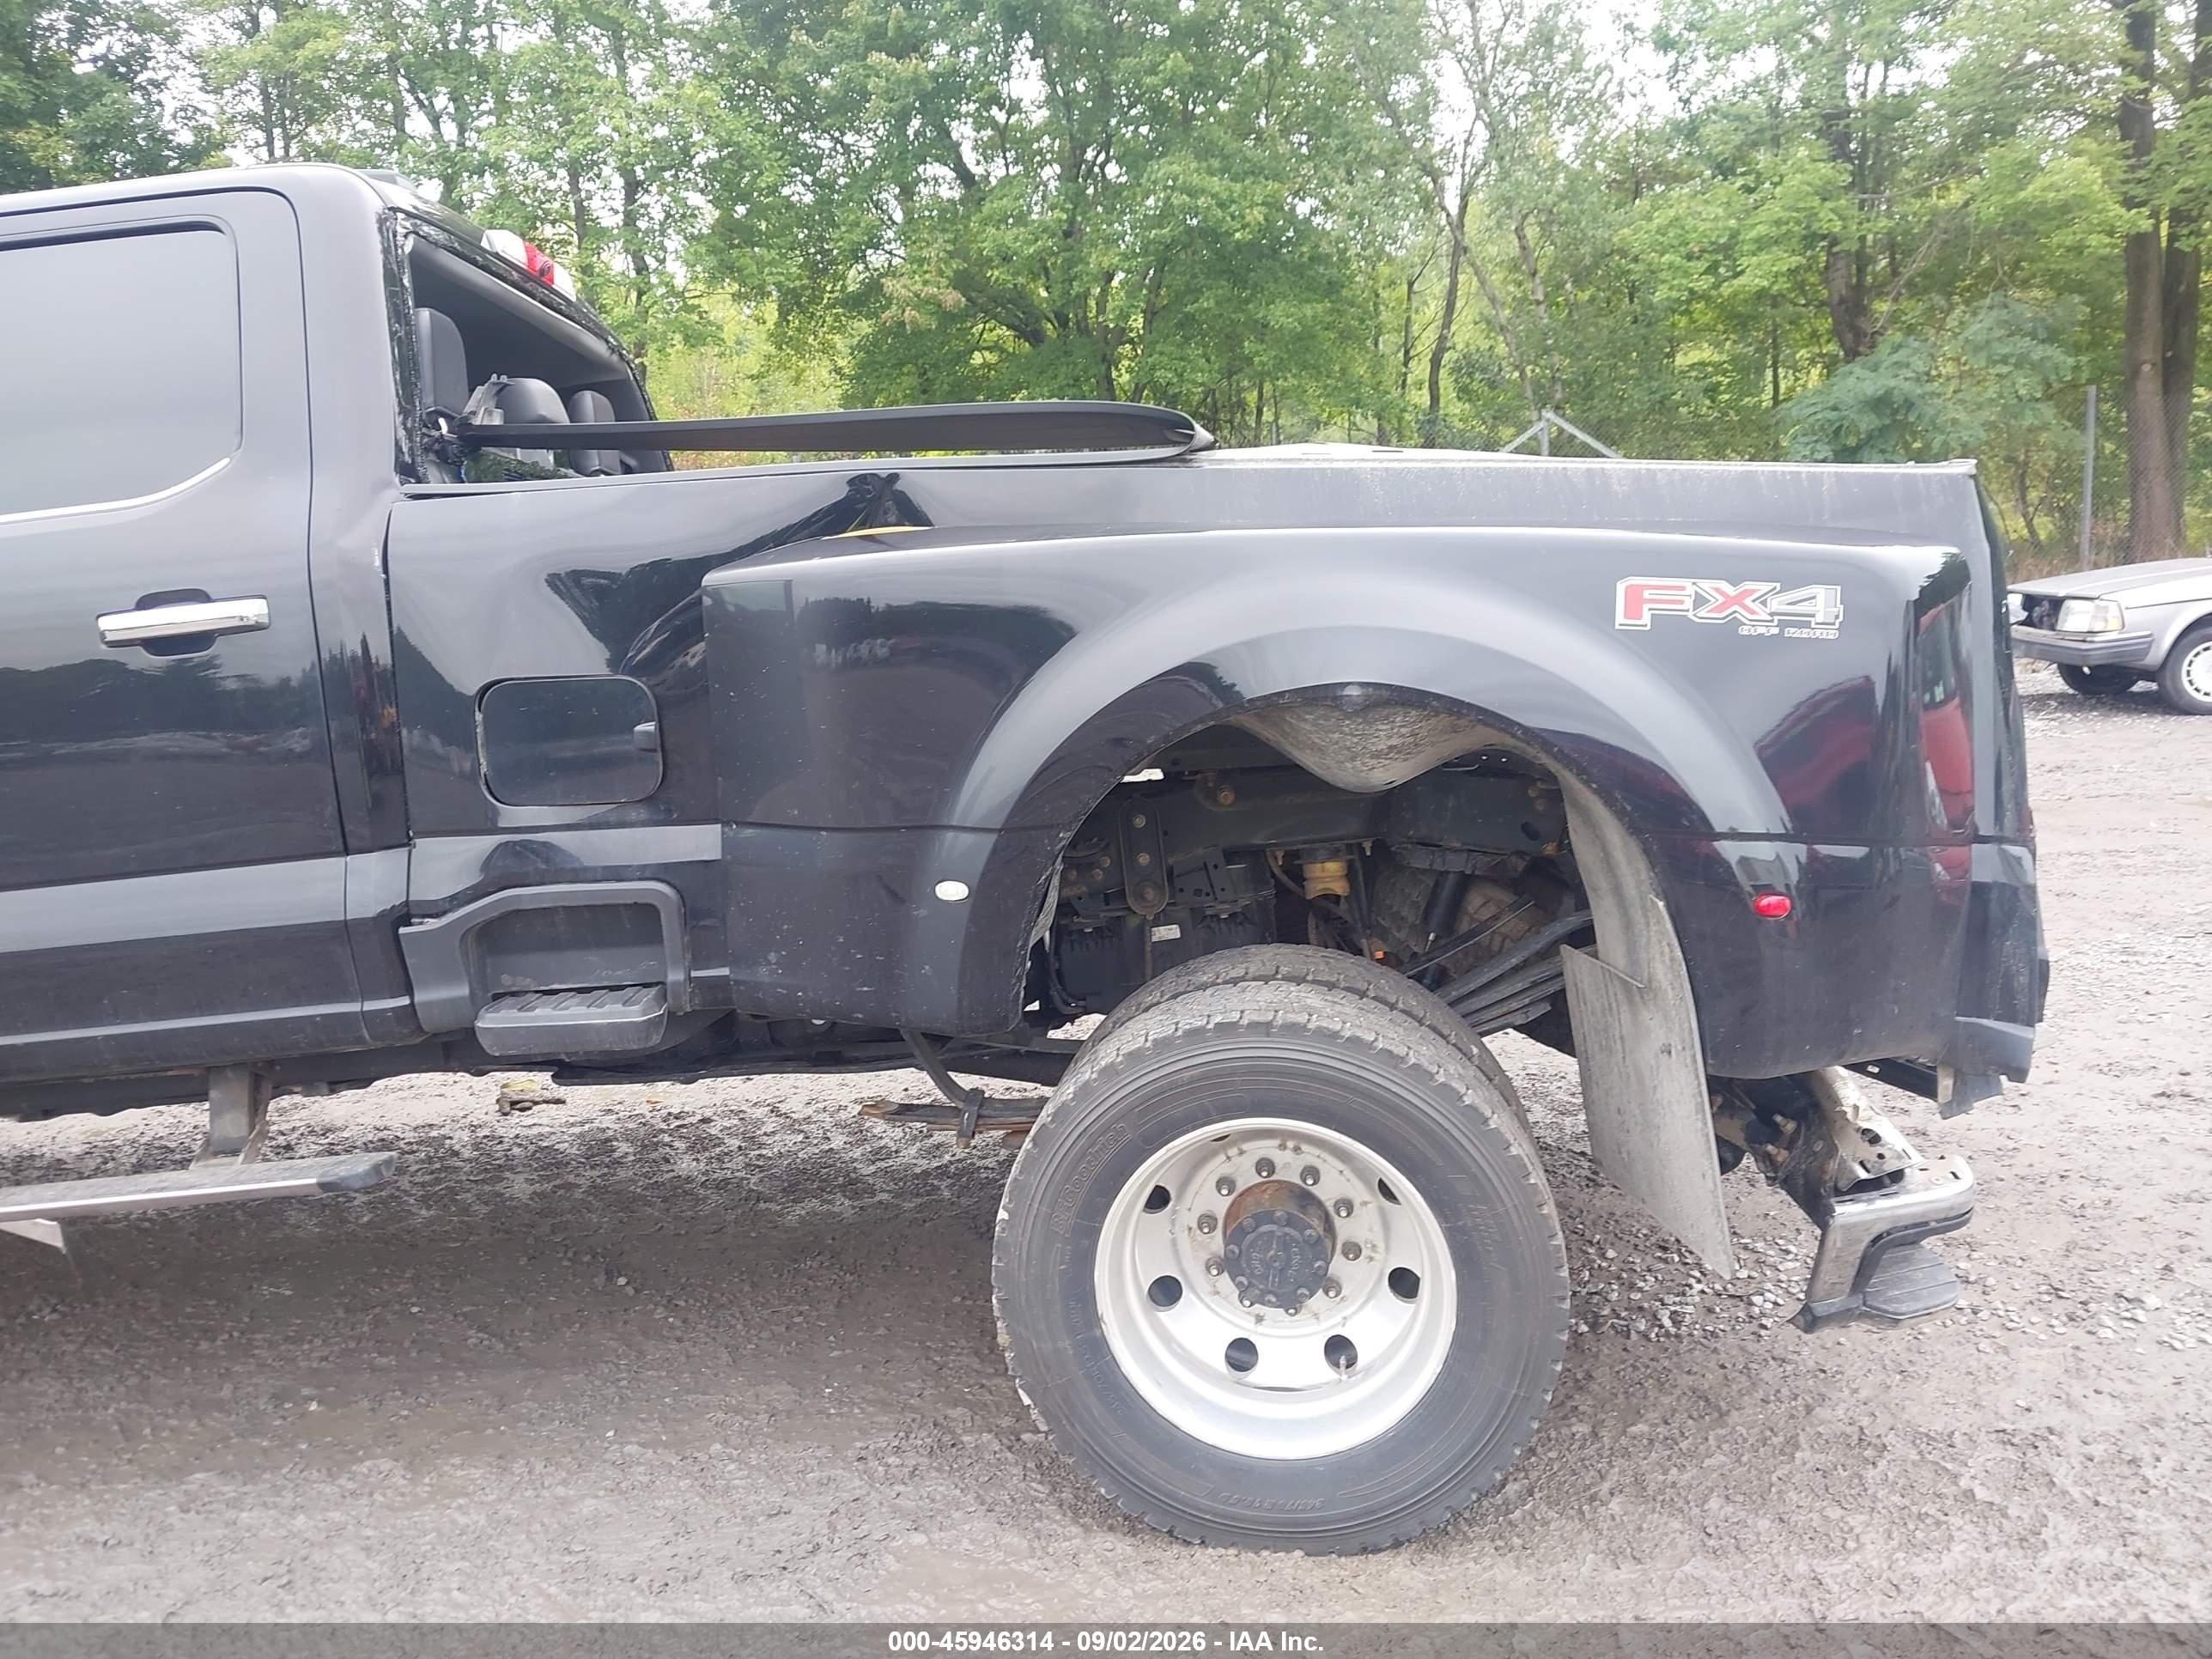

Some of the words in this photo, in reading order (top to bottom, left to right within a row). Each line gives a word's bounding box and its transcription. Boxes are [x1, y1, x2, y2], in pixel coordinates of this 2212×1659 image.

[1615, 576, 1844, 630] FX4
[1738, 625, 1780, 637] OFF
[1784, 628, 1840, 640] ROAD
[1050, 1123, 1128, 1236] BFGoodrich
